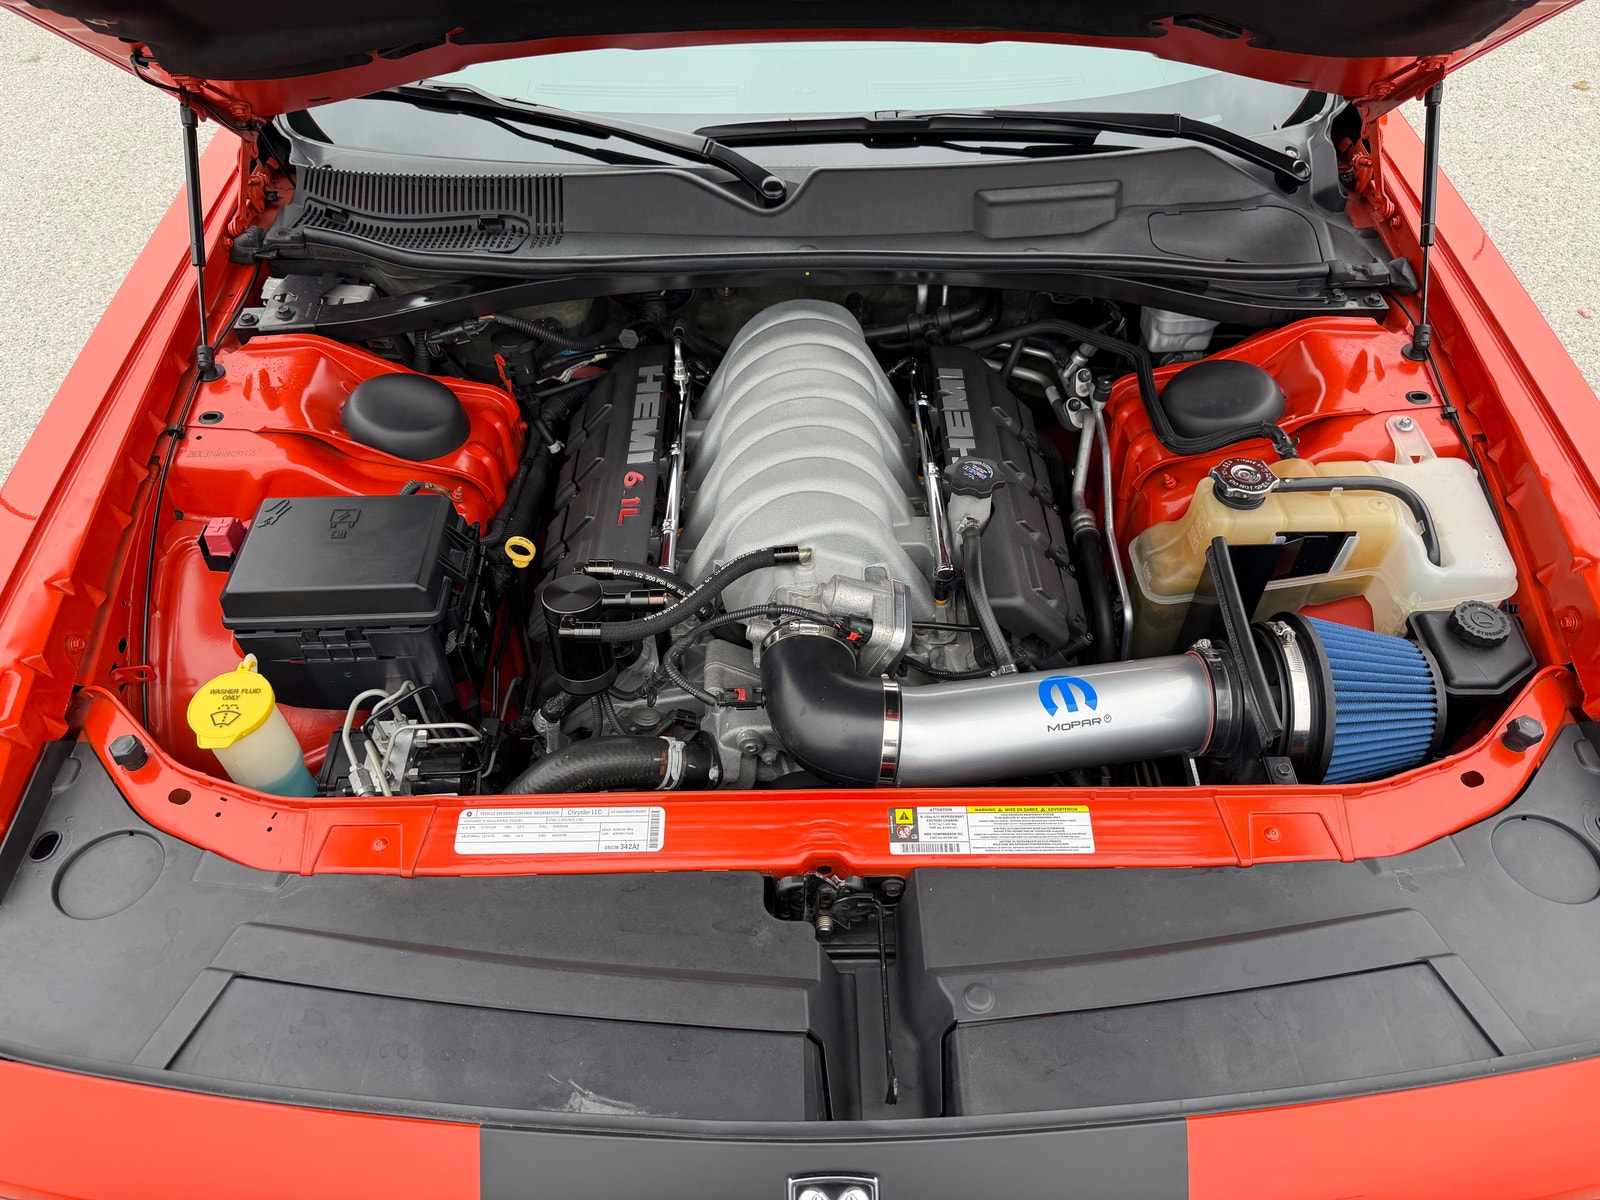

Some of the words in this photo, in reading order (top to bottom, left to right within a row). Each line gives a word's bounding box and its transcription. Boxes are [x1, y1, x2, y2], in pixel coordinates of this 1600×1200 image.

[627, 365, 664, 465] HEMI
[617, 470, 645, 526] 6.1L
[644, 574, 656, 582] 300
[655, 577, 667, 586] PSI
[666, 582, 677, 591] WP
[662, 602, 679, 615] MADE
[642, 614, 656, 622] USA
[1047, 717, 1102, 732] MOPAR
[567, 809, 591, 817] Chrysler
[619, 843, 640, 851] 342AJ
